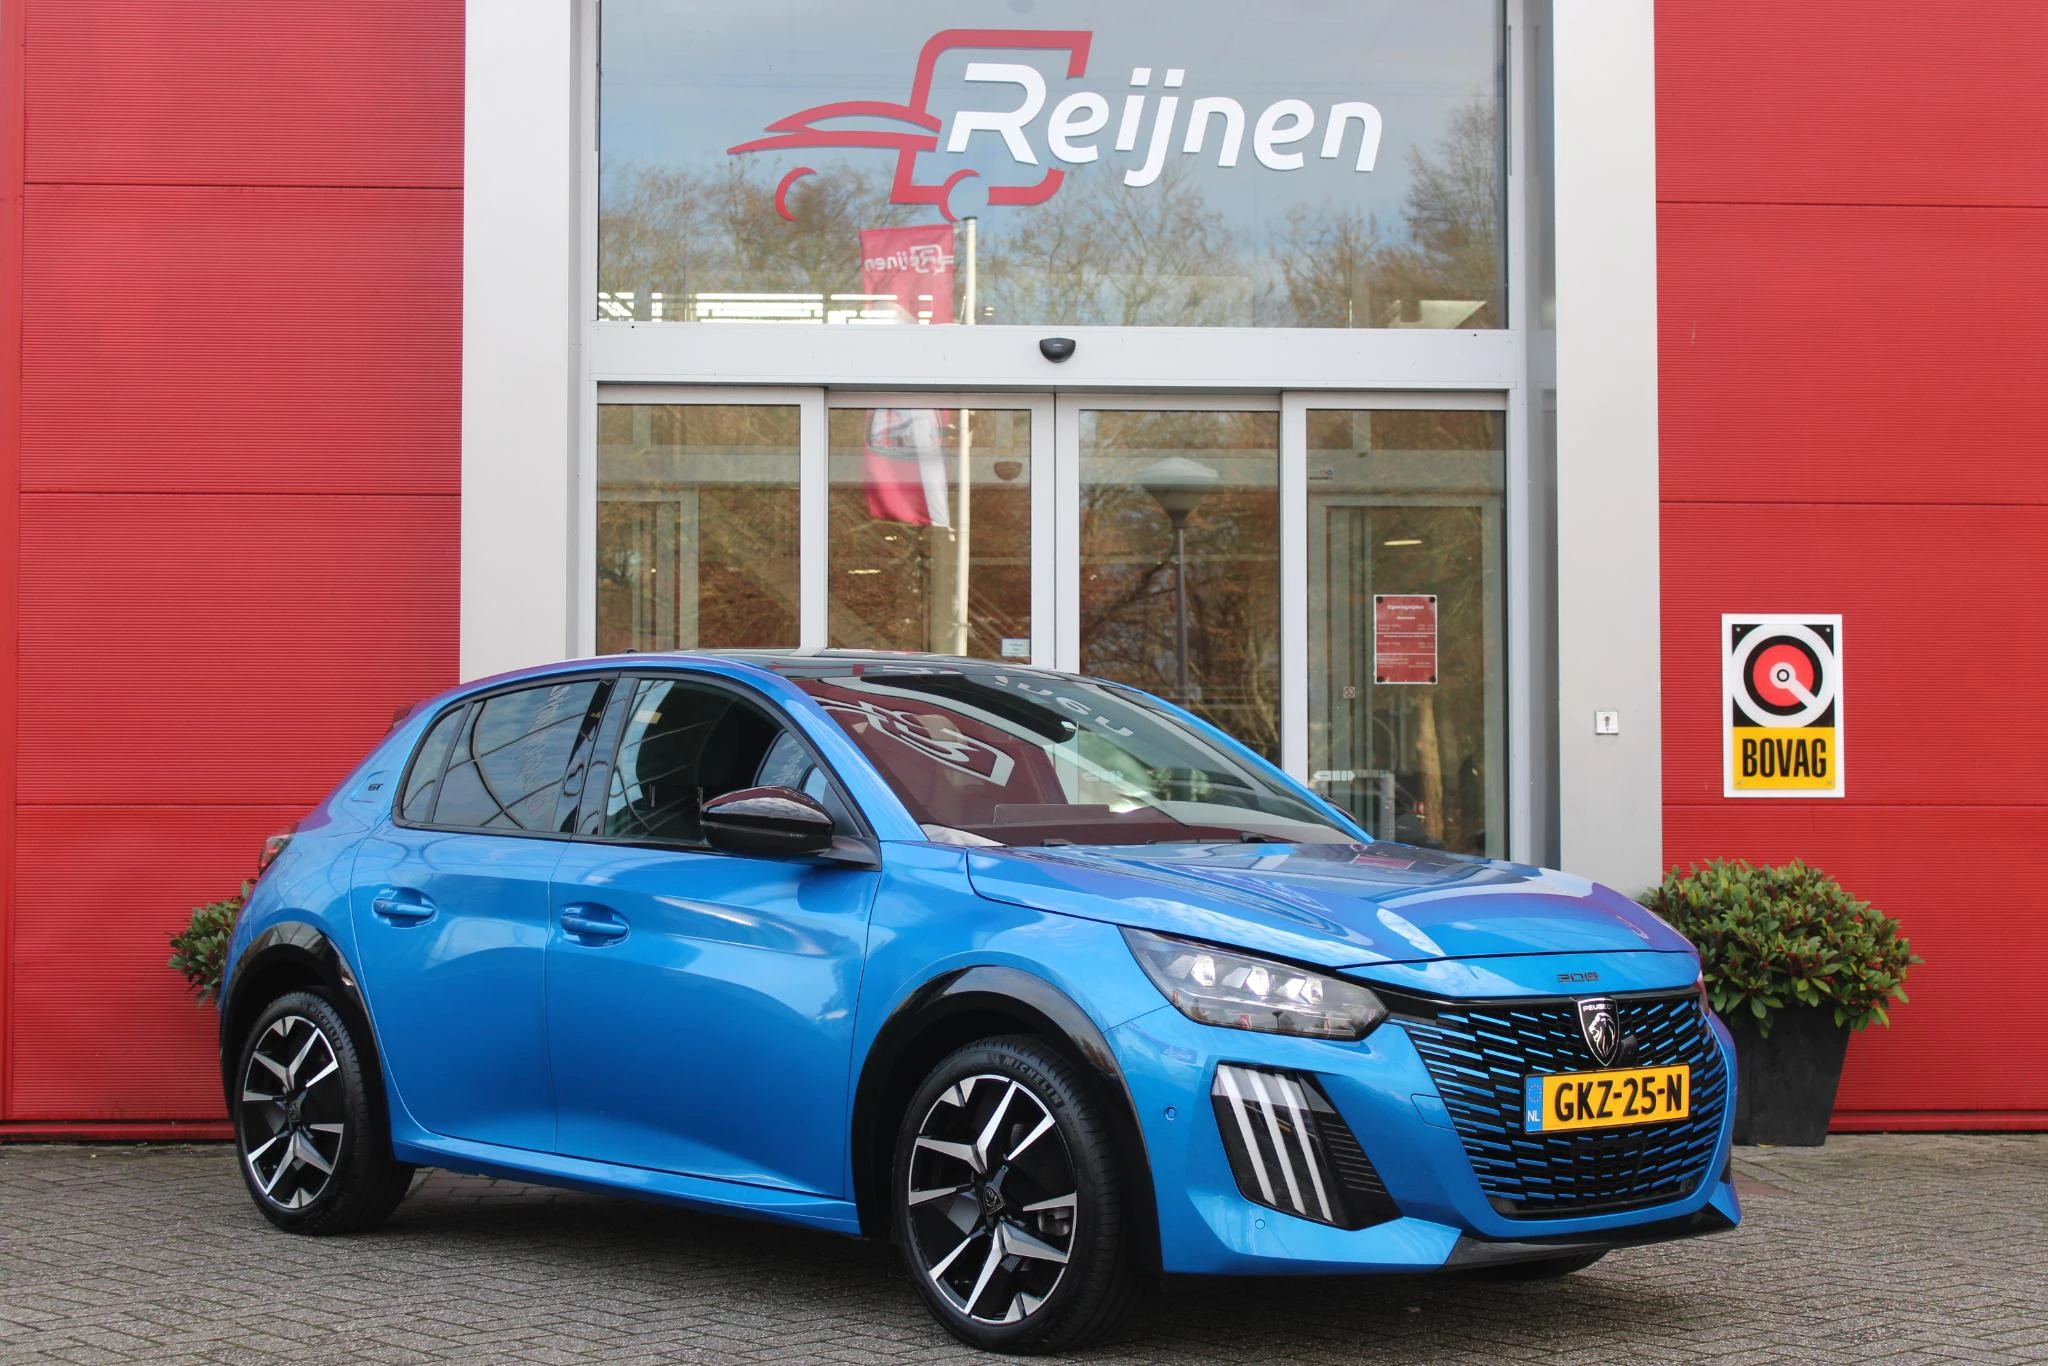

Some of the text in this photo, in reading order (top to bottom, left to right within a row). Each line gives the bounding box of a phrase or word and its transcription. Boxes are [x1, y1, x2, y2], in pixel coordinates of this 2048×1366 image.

[947, 62, 1383, 187] Reijnen
[1742, 738, 1827, 778] BOVAG
[367, 783, 384, 791] GT
[1557, 972, 1599, 983] 208
[1003, 1055, 1065, 1108] MICHELIN
[1527, 1074, 1682, 1122] NL GKZ-25-N
